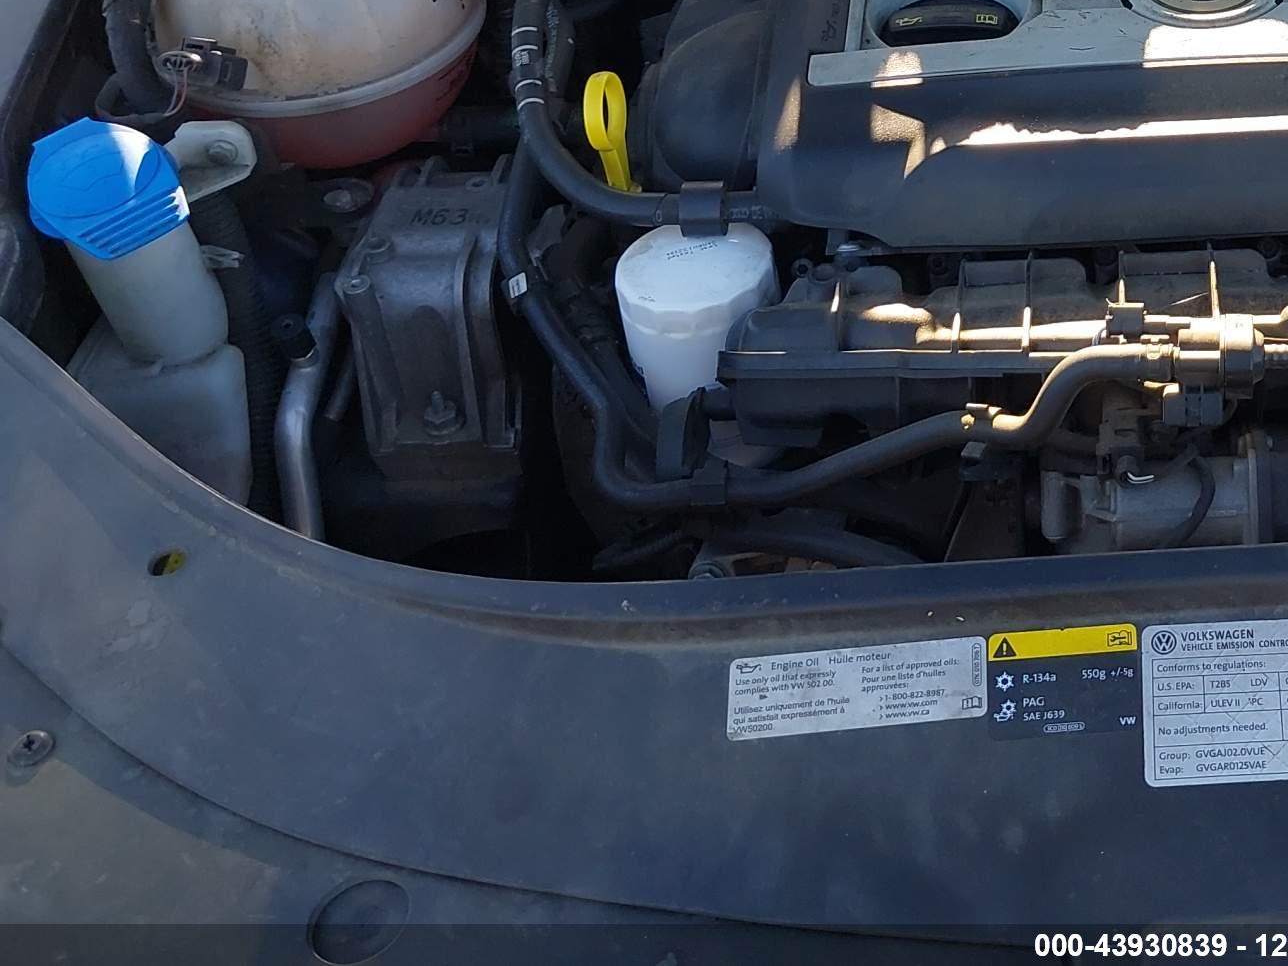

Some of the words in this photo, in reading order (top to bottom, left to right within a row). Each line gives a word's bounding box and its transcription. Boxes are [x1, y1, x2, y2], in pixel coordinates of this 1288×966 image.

[410, 208, 469, 226] M63
[1180, 629, 1254, 642] VOLKSWAGEN
[1181, 643, 1213, 651] VEHICLE
[1217, 641, 1254, 650] EMISSION
[771, 662, 803, 672] Engine
[806, 658, 819, 666] Oil
[828, 655, 853, 664] Huile
[856, 653, 891, 662] moteur
[862, 666, 875, 674] For
[905, 660, 942, 670] approved
[1157, 663, 1200, 672] Conforms
[752, 676, 768, 685] only
[800, 671, 836, 680] expressly
[1023, 673, 1057, 683] R-134a
[1081, 669, 1106, 680] 550g
[1110, 667, 1134, 678] +/-5g
[1250, 678, 1268, 686] LDV
[734, 687, 769, 696] complies
[807, 680, 820, 688] 502
[765, 701, 812, 711] uniquement
[886, 700, 938, 709] www.vw.com
[1023, 697, 1045, 707] PAG
[1211, 699, 1233, 707] ULEV
[885, 710, 930, 719] www.vw.ca
[1023, 712, 1040, 721] SAE
[1043, 710, 1064, 720] J639
[1120, 716, 1136, 724] VW
[733, 717, 746, 725] qui
[1174, 724, 1230, 736] adjustments
[1233, 723, 1268, 731] needed.
[1160, 752, 1190, 762] Group:
[1160, 766, 1184, 775] Evap:
